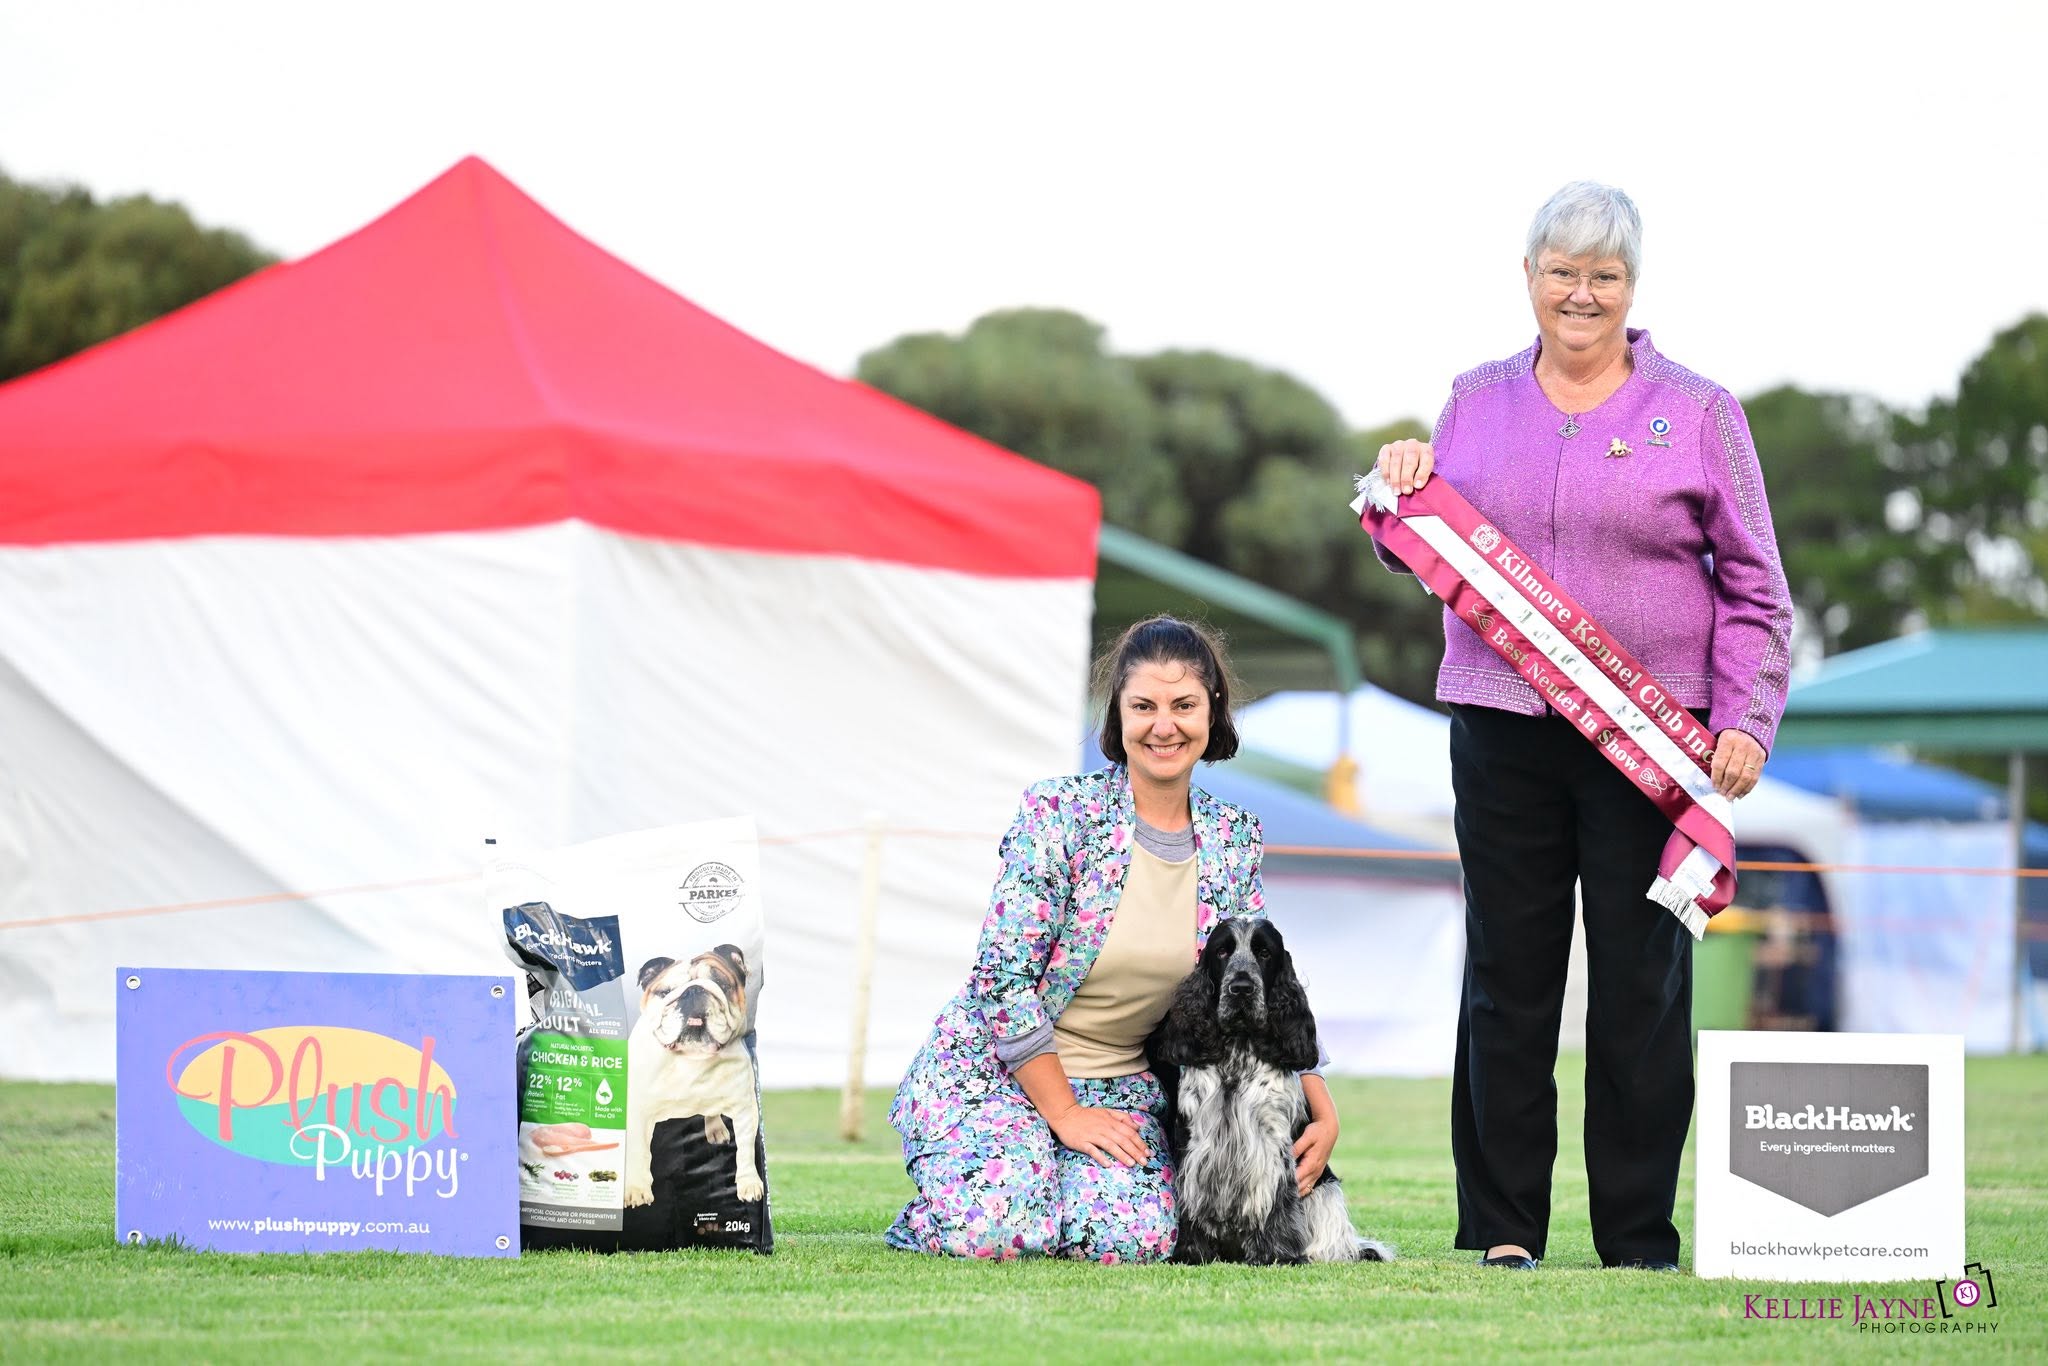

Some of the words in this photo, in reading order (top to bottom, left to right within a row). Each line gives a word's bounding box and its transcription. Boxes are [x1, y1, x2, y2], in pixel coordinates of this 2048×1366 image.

[1495, 546, 1572, 623] Kilmore
[1571, 617, 1642, 688] Kennel
[1639, 685, 1683, 732] Club
[1491, 628, 1530, 666] Best
[1526, 661, 1580, 714] Neuter
[1578, 710, 1598, 734] In
[1597, 729, 1640, 772] Show
[715, 866, 732, 876] MADE
[689, 888, 738, 901] PARKES
[532, 1051, 577, 1066] CHICKEN
[580, 1055, 588, 1067] &
[591, 1057, 623, 1068] RICE
[166, 1031, 459, 1143] Plush
[530, 1074, 551, 1088] 22%
[557, 1077, 582, 1092] 12%
[1760, 1141, 1791, 1155] Every
[1793, 1142, 1850, 1155] ingredient
[1851, 1142, 1895, 1153] matters
[208, 1217, 431, 1237] www.plushpuppy.com.au
[725, 1221, 750, 1233] 20kg
[1731, 1241, 1929, 1260] blackhawkpetcare.com
